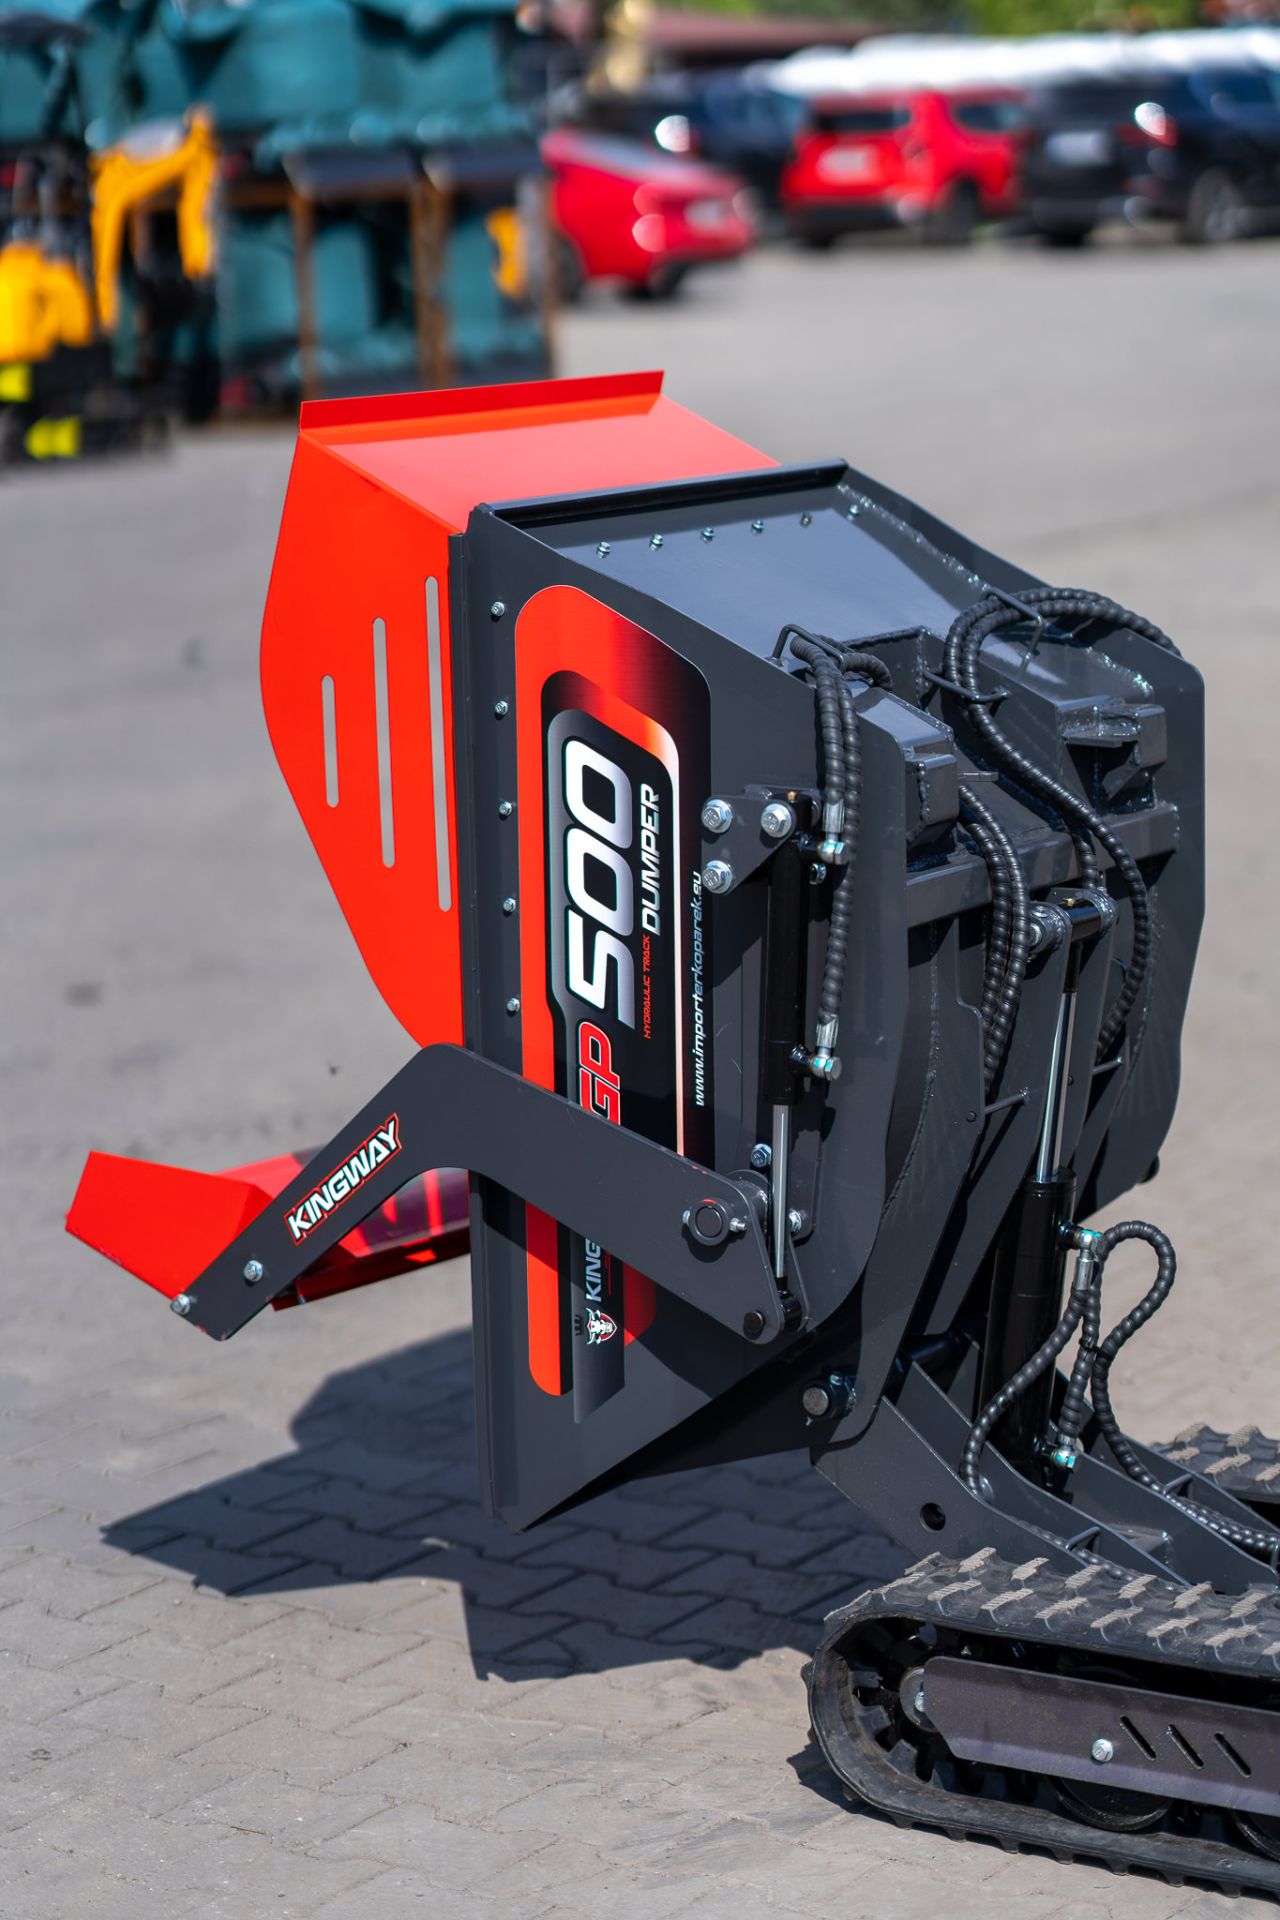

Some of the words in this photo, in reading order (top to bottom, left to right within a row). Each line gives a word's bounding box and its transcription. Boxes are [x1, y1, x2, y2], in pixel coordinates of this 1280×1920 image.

[566, 740, 635, 1029] 500
[641, 783, 660, 936] DUMPER
[642, 934, 650, 972] TRACK
[643, 974, 651, 1039] HYDRAULIC
[691, 871, 706, 1106] www.importerkoparek.eu
[287, 1119, 398, 1240] KINGWAY
